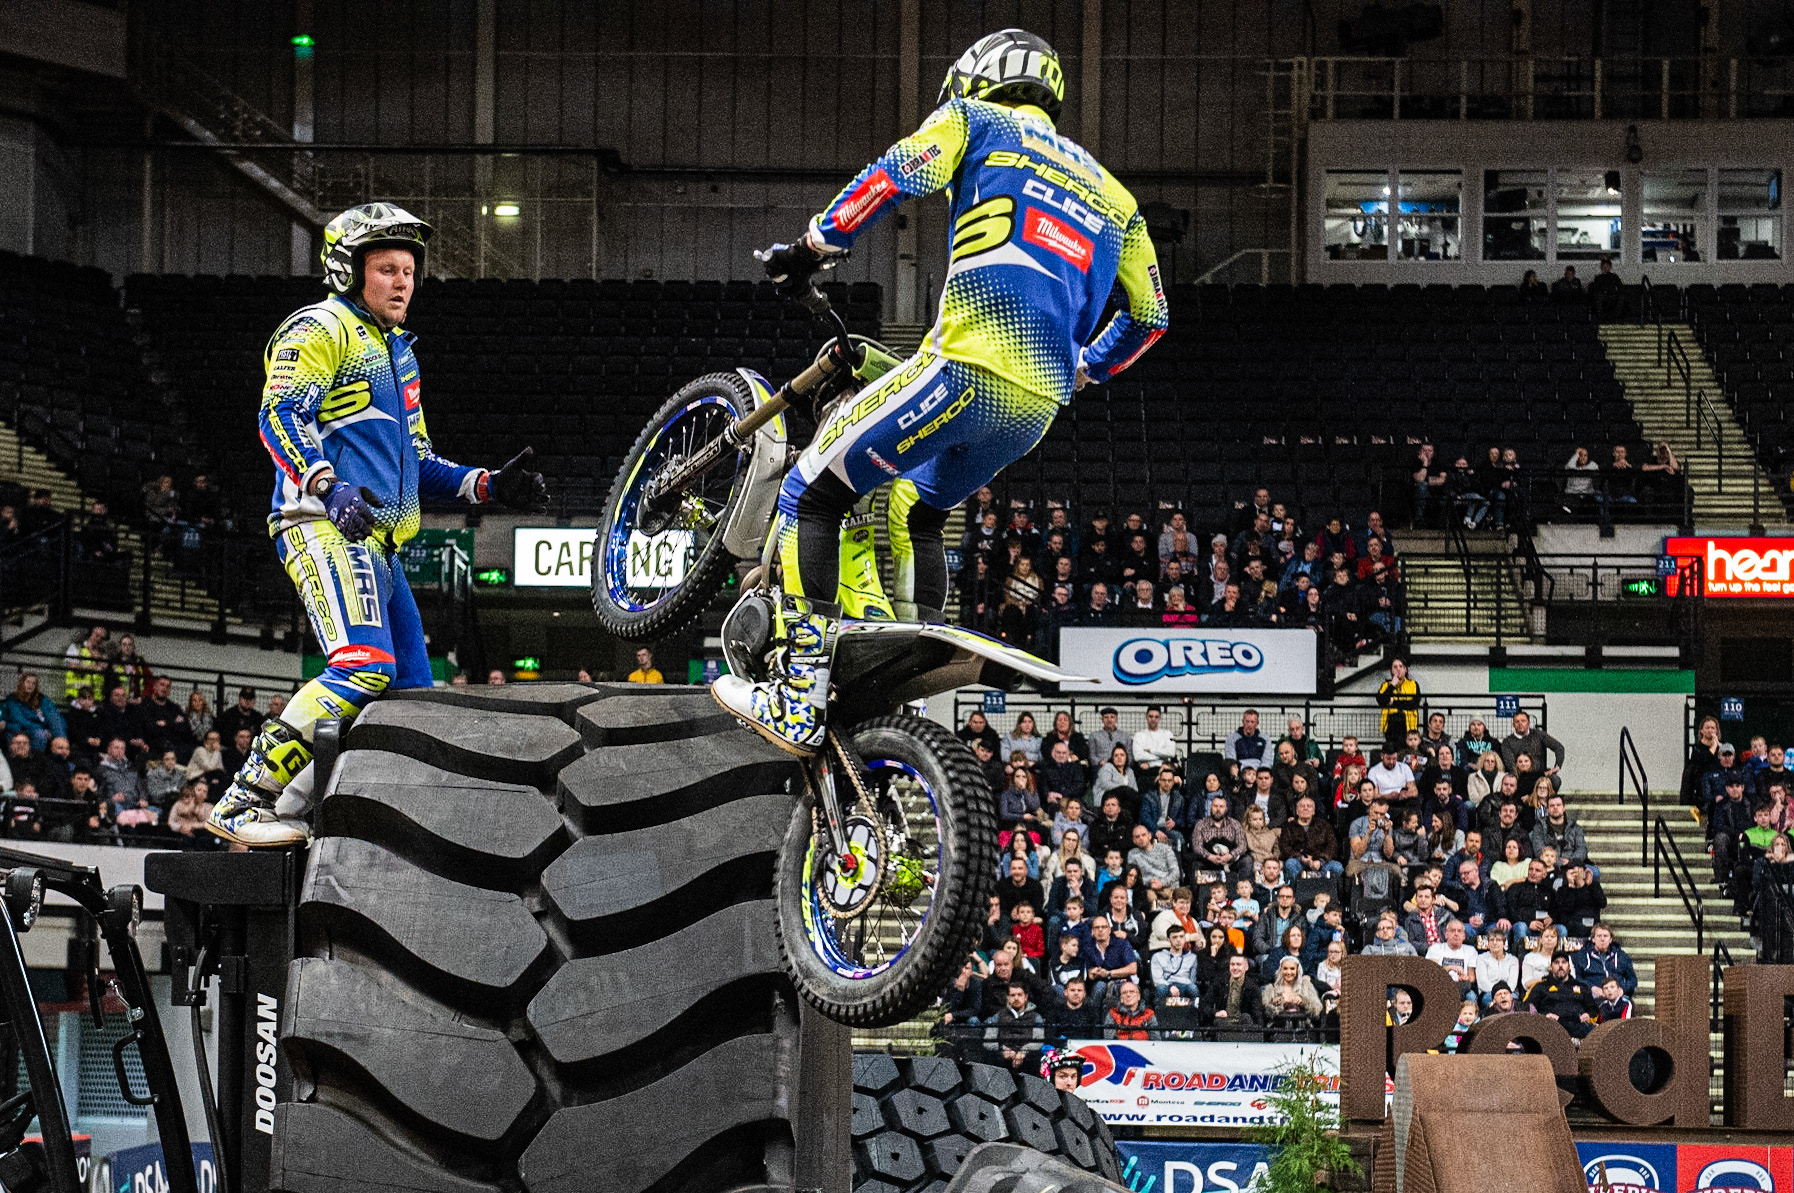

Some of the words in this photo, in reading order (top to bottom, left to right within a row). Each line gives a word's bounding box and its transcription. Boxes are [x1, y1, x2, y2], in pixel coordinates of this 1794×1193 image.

[838, 179, 889, 226] Milwaukee
[985, 151, 1128, 229] SHERCO
[1022, 178, 1105, 235] CLICE
[1036, 217, 1087, 256] Milwaukee
[896, 385, 976, 454] SHERCO
[897, 383, 949, 430] CLICE
[534, 540, 673, 577] CARNG
[1658, 560, 1675, 568] 211
[288, 525, 338, 642] SHERCO
[345, 546, 380, 625] MRS
[1729, 583, 1742, 594] up
[1115, 637, 1262, 681] OREO
[1499, 700, 1517, 709] 111
[1724, 702, 1742, 712] 110
[281, 747, 306, 777] G
[255, 992, 278, 1135] DOOSAN
[1164, 1161, 1275, 1193] DSA
